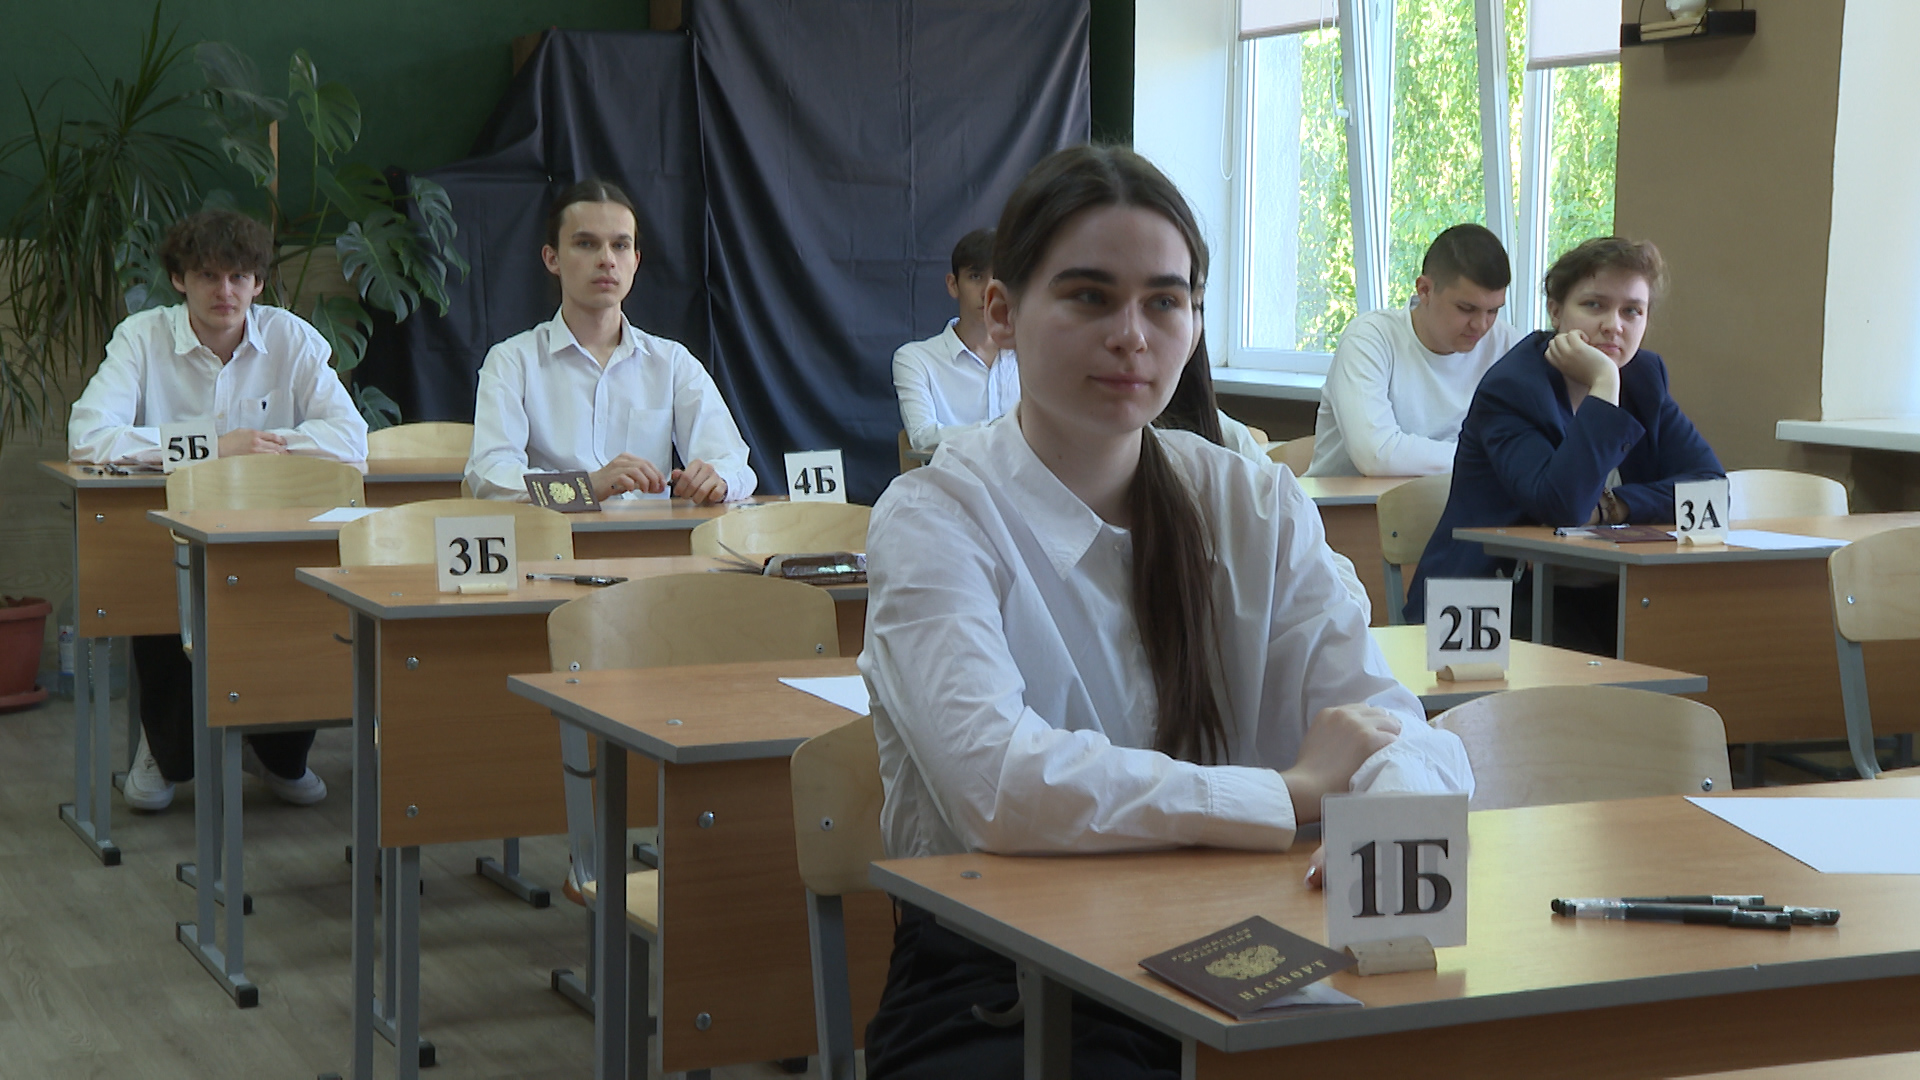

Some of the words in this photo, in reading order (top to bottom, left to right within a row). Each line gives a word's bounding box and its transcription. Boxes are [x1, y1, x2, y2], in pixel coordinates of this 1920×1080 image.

[168, 435, 210, 462] 5Б
[794, 465, 836, 495] 4Б
[1680, 499, 1722, 532] 3А
[449, 537, 508, 576] 3Б
[1439, 605, 1501, 652] 2Б
[1350, 838, 1452, 918] 1Б
[1238, 959, 1327, 1001] ПАСПОРТ
